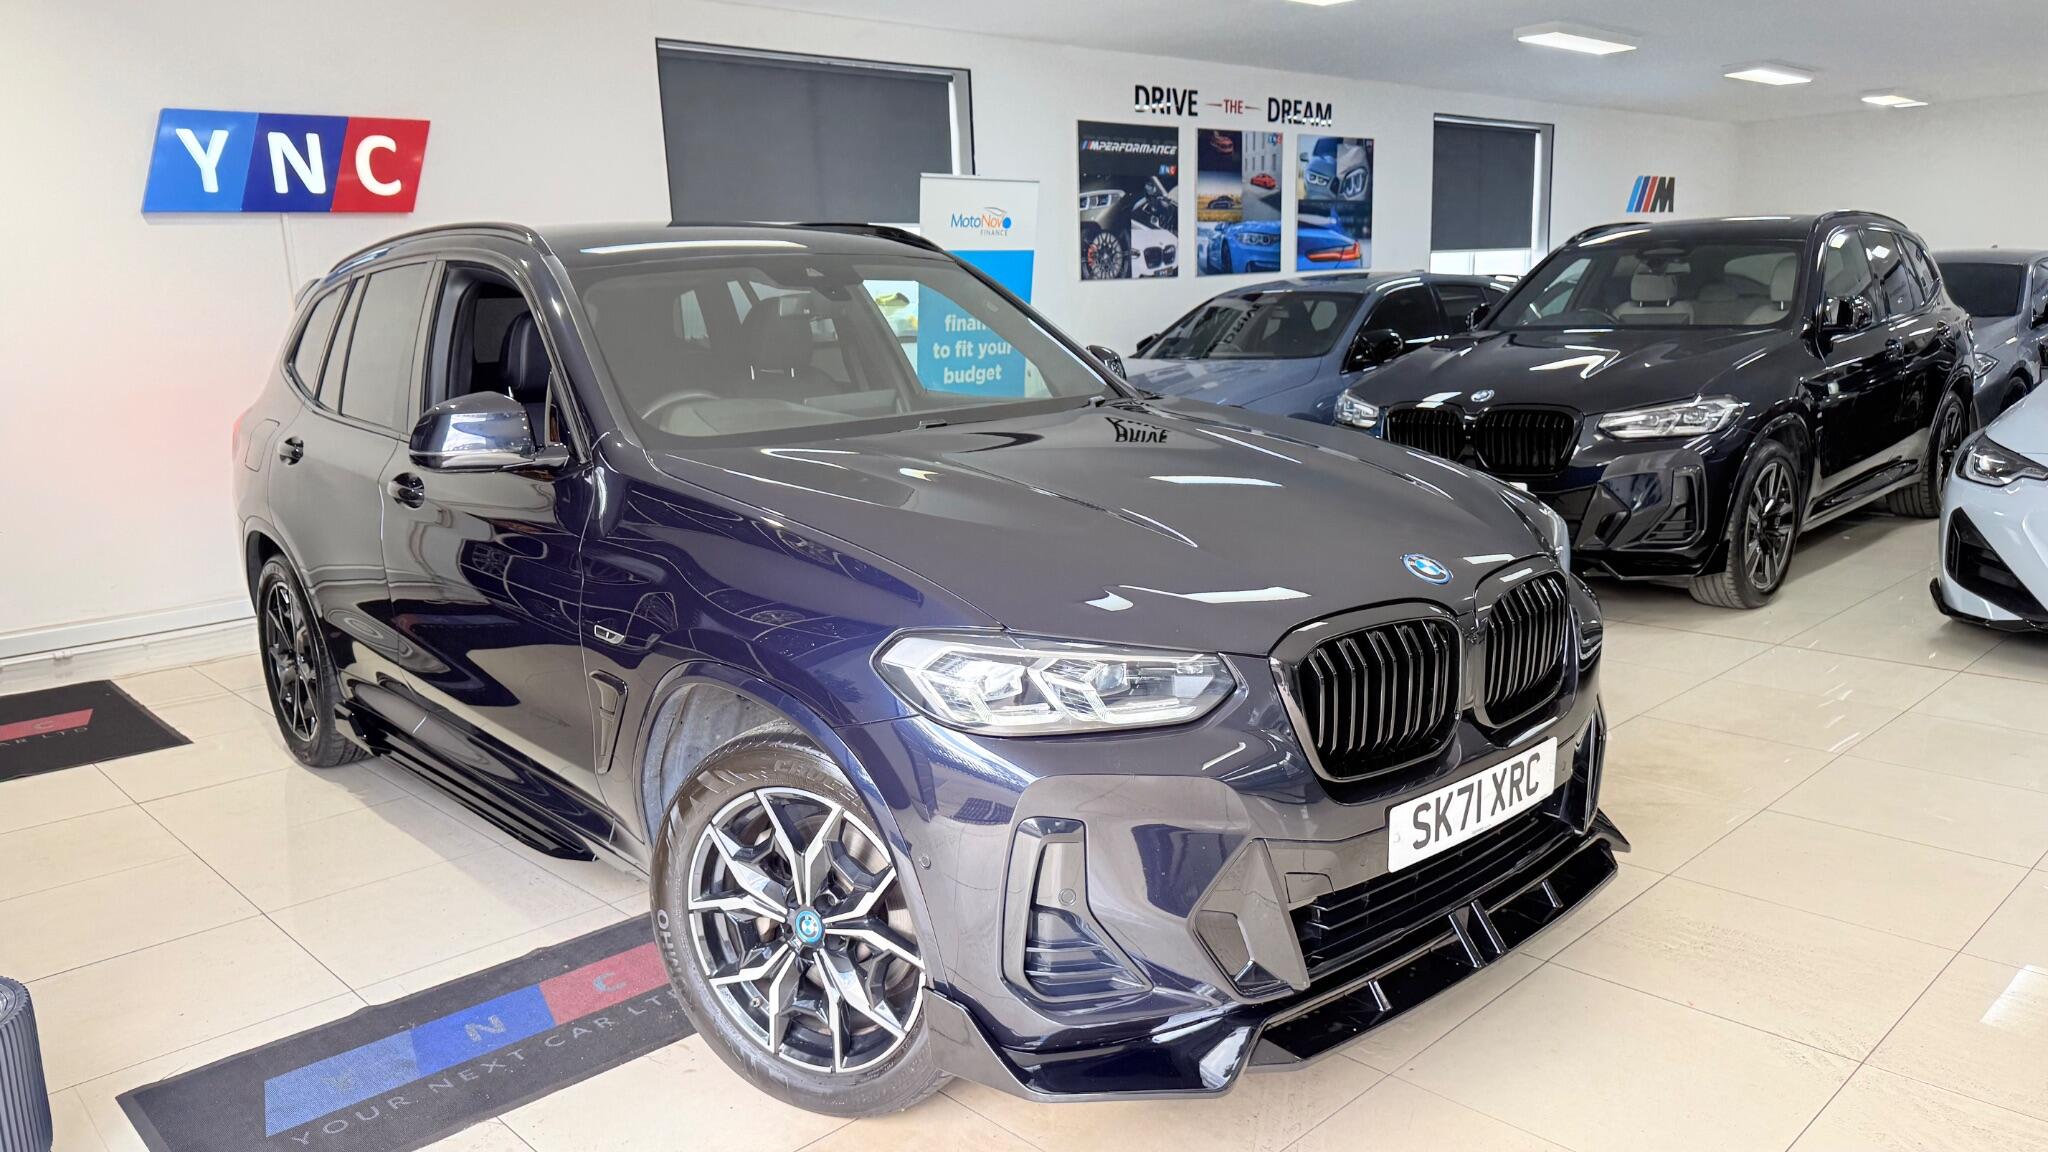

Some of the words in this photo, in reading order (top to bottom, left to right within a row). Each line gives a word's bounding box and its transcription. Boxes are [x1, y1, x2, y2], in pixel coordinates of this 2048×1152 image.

[1134, 84, 1198, 116] DRIVE
[1223, 99, 1243, 115] THE
[1267, 97, 1332, 127] DREAM
[933, 343, 950, 359] to
[955, 340, 974, 357] fit
[978, 341, 1012, 359] your
[943, 364, 1003, 384] budget
[1412, 779, 1483, 850] SK71
[1490, 752, 1541, 816] XRC
[292, 1096, 412, 1145] YOUR
[428, 1049, 526, 1094] NEXT
[545, 1016, 616, 1048] CAR
